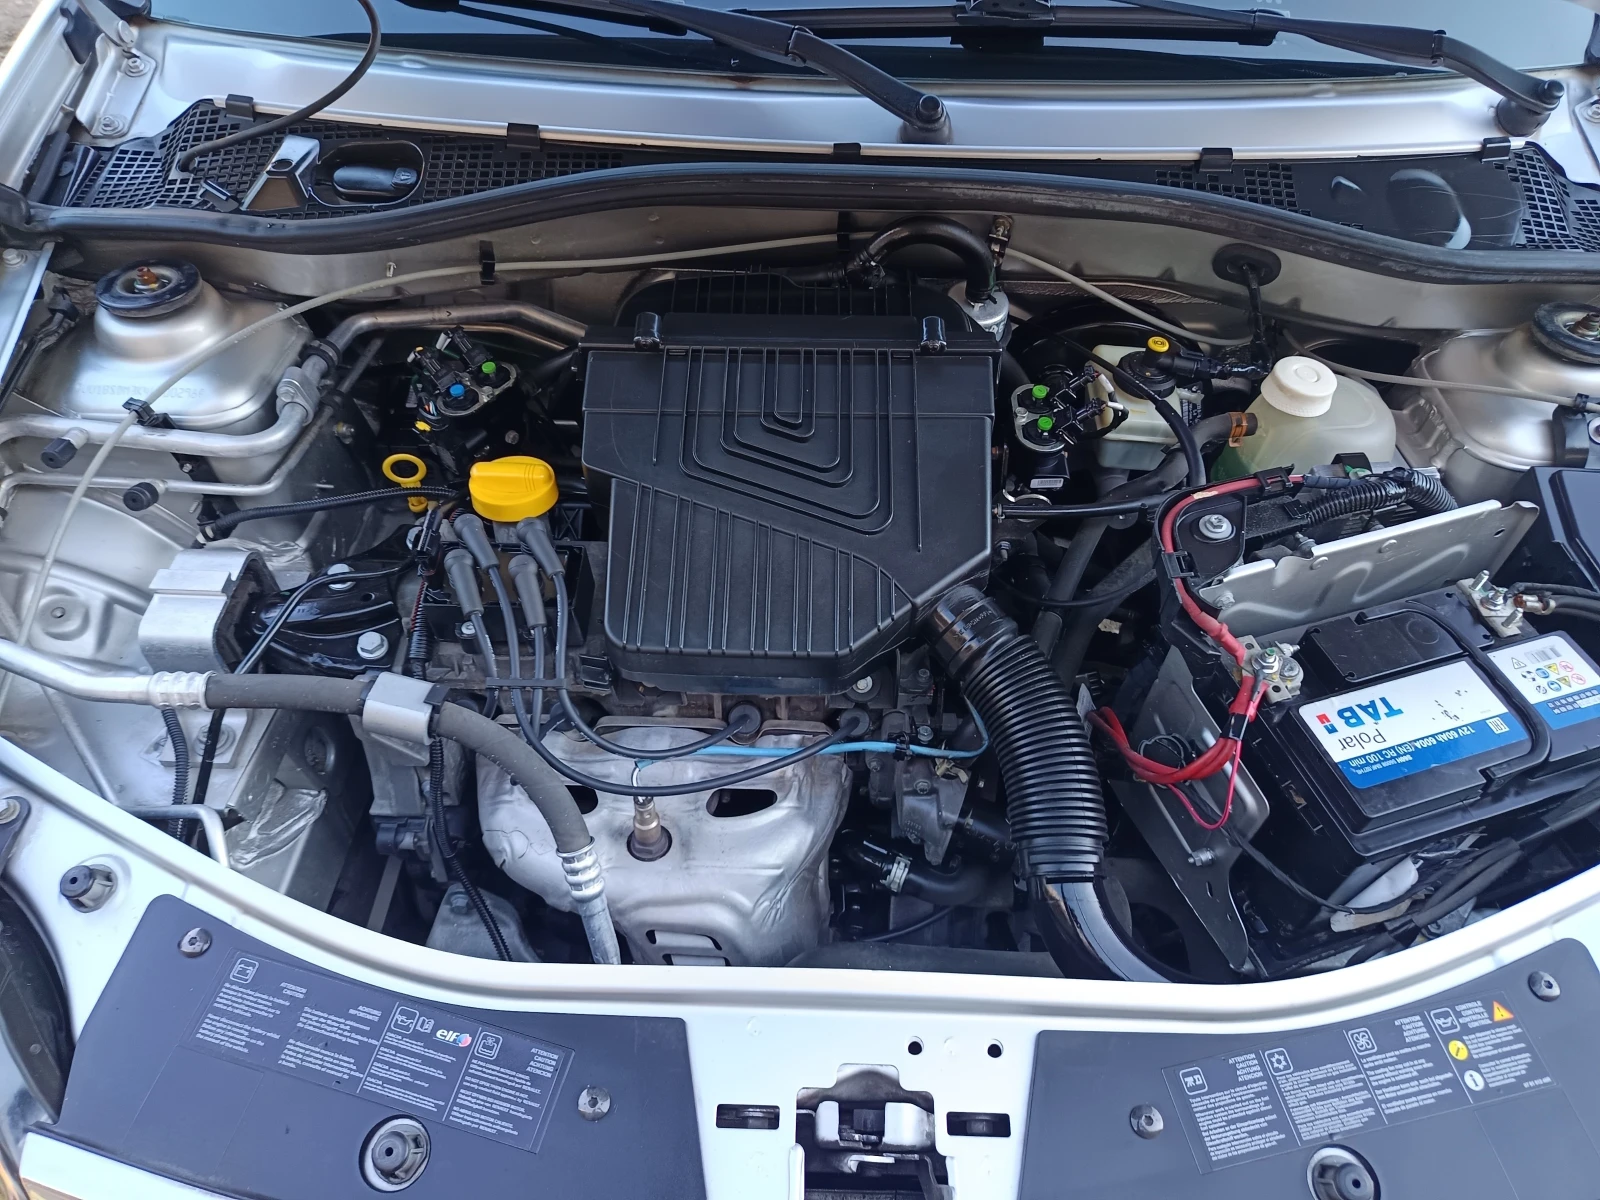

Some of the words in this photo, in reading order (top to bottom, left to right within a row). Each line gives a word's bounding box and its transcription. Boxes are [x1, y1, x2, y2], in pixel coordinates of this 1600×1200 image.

[1337, 697, 1404, 727] TAB
[1435, 730, 1458, 741] 60Ah
[1457, 725, 1474, 736] 12V
[1338, 728, 1385, 750] Polar
[1412, 736, 1436, 748] 600A
[1381, 748, 1396, 758] RC
[1394, 741, 1414, 754] (EN)
[1348, 757, 1366, 767] min
[1365, 752, 1383, 763] 100
[1394, 1015, 1420, 1025] ATTENTION
[1402, 1021, 1423, 1030] CAUTION
[436, 1029, 460, 1042] elf
[1228, 1053, 1255, 1063] ATTENTION
[1235, 1059, 1258, 1068] CAUTION
[1236, 1064, 1260, 1075] ACHTUNG
